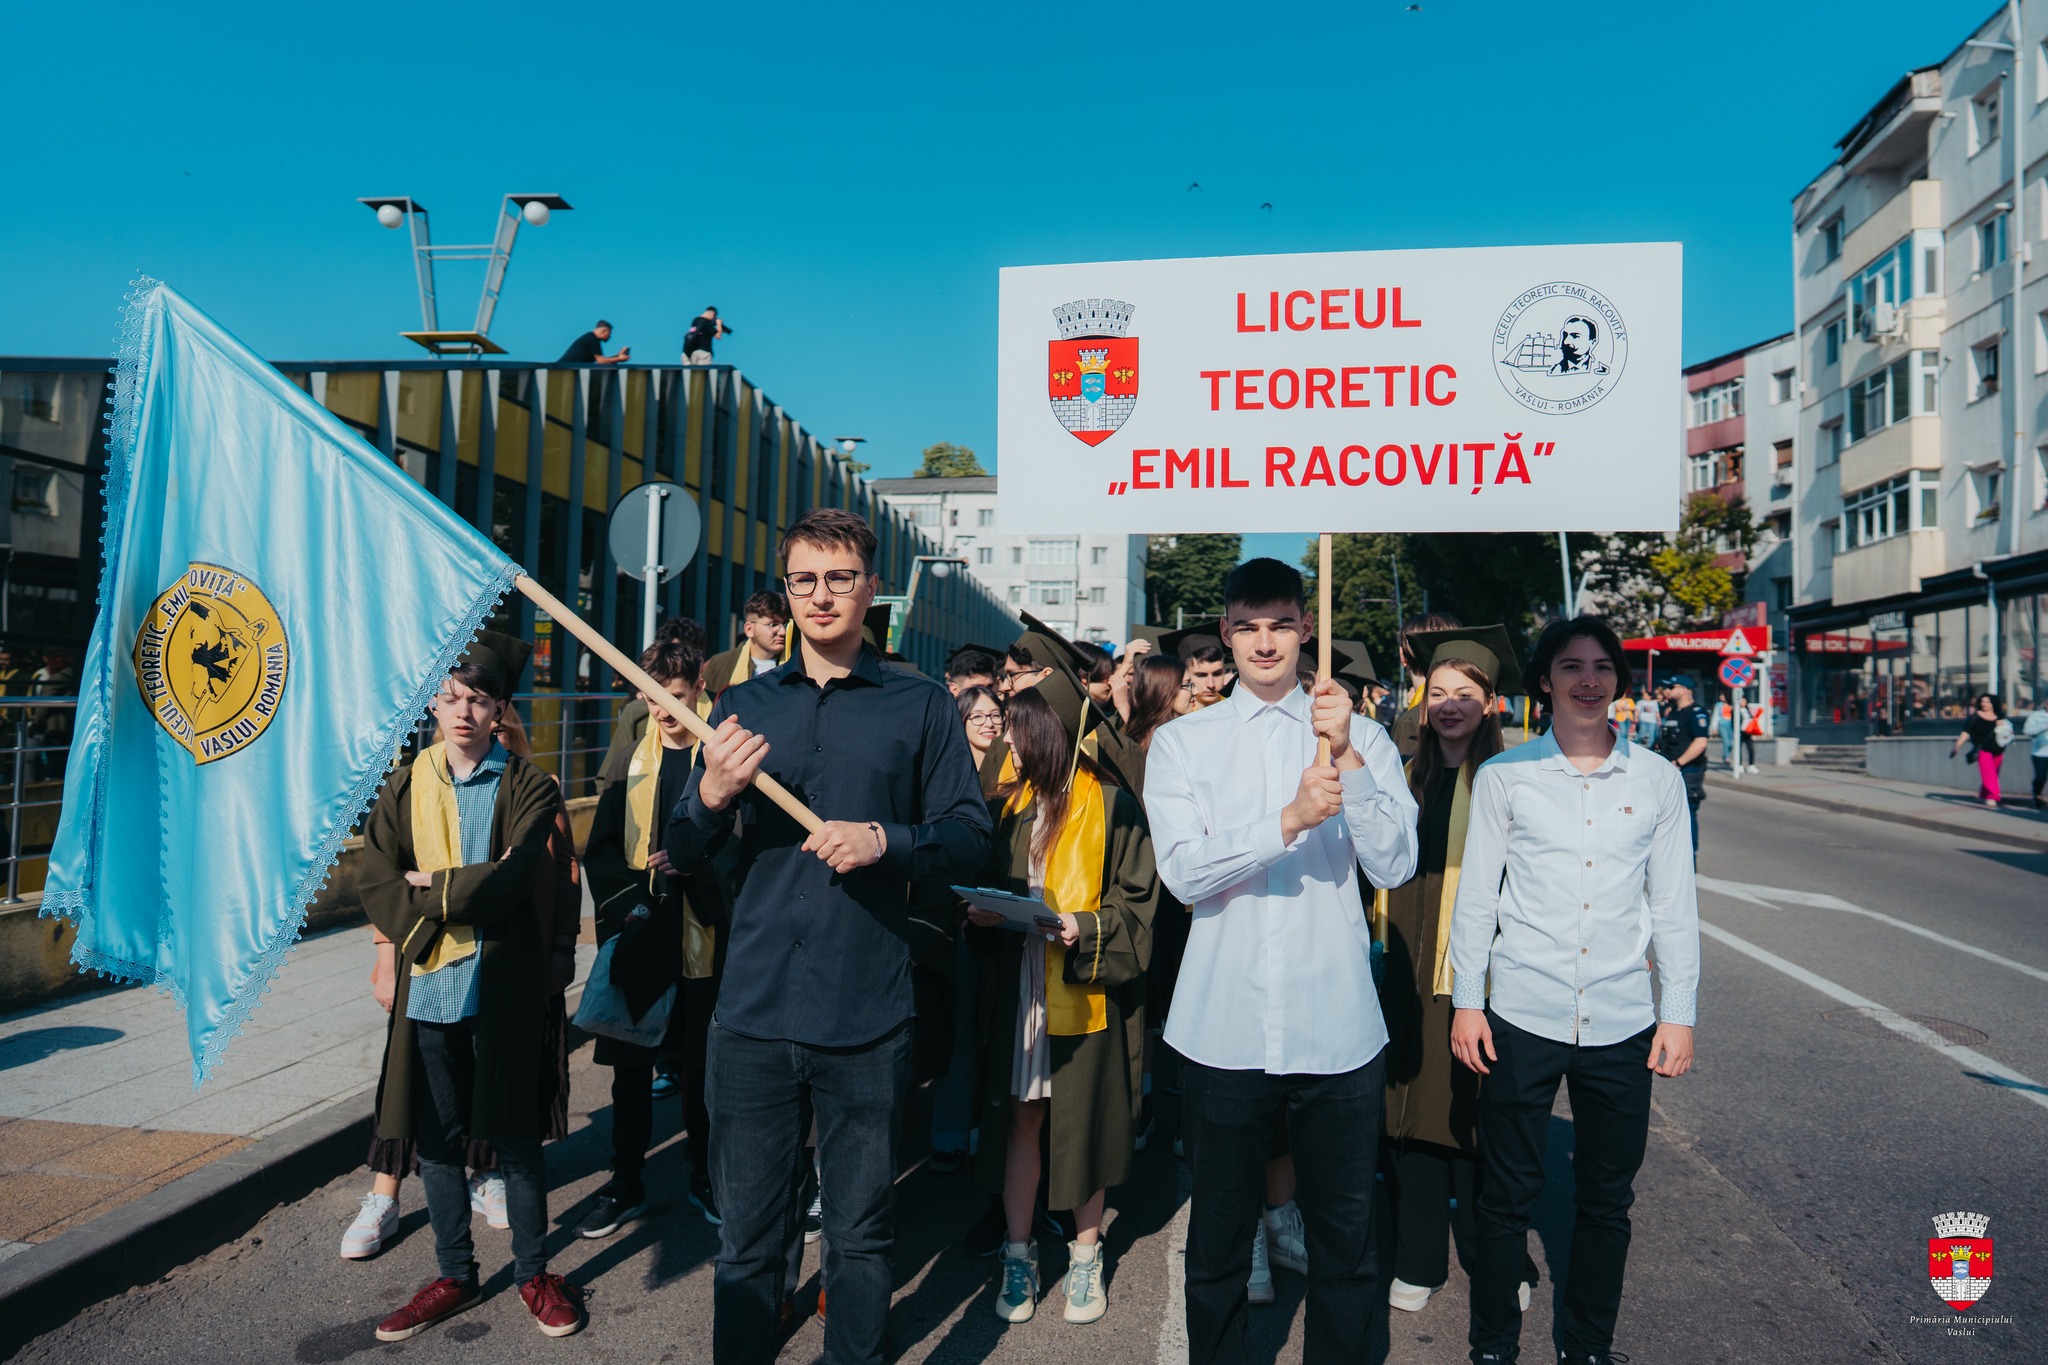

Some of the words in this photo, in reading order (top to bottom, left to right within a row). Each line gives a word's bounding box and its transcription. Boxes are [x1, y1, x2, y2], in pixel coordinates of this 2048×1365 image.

[1236, 286, 1423, 333] LICEUL
[1495, 311, 1517, 345] LICEUL
[1512, 284, 1558, 311] TEORETIC
[1200, 364, 1457, 411] TEORETIC
[1515, 386, 1548, 410] VASLUI
[1107, 447, 1250, 496] „EMIL
[140, 622, 168, 703] TEORETIC
[200, 717, 259, 758] VASLUI
[254, 642, 283, 717] ROMANIA
